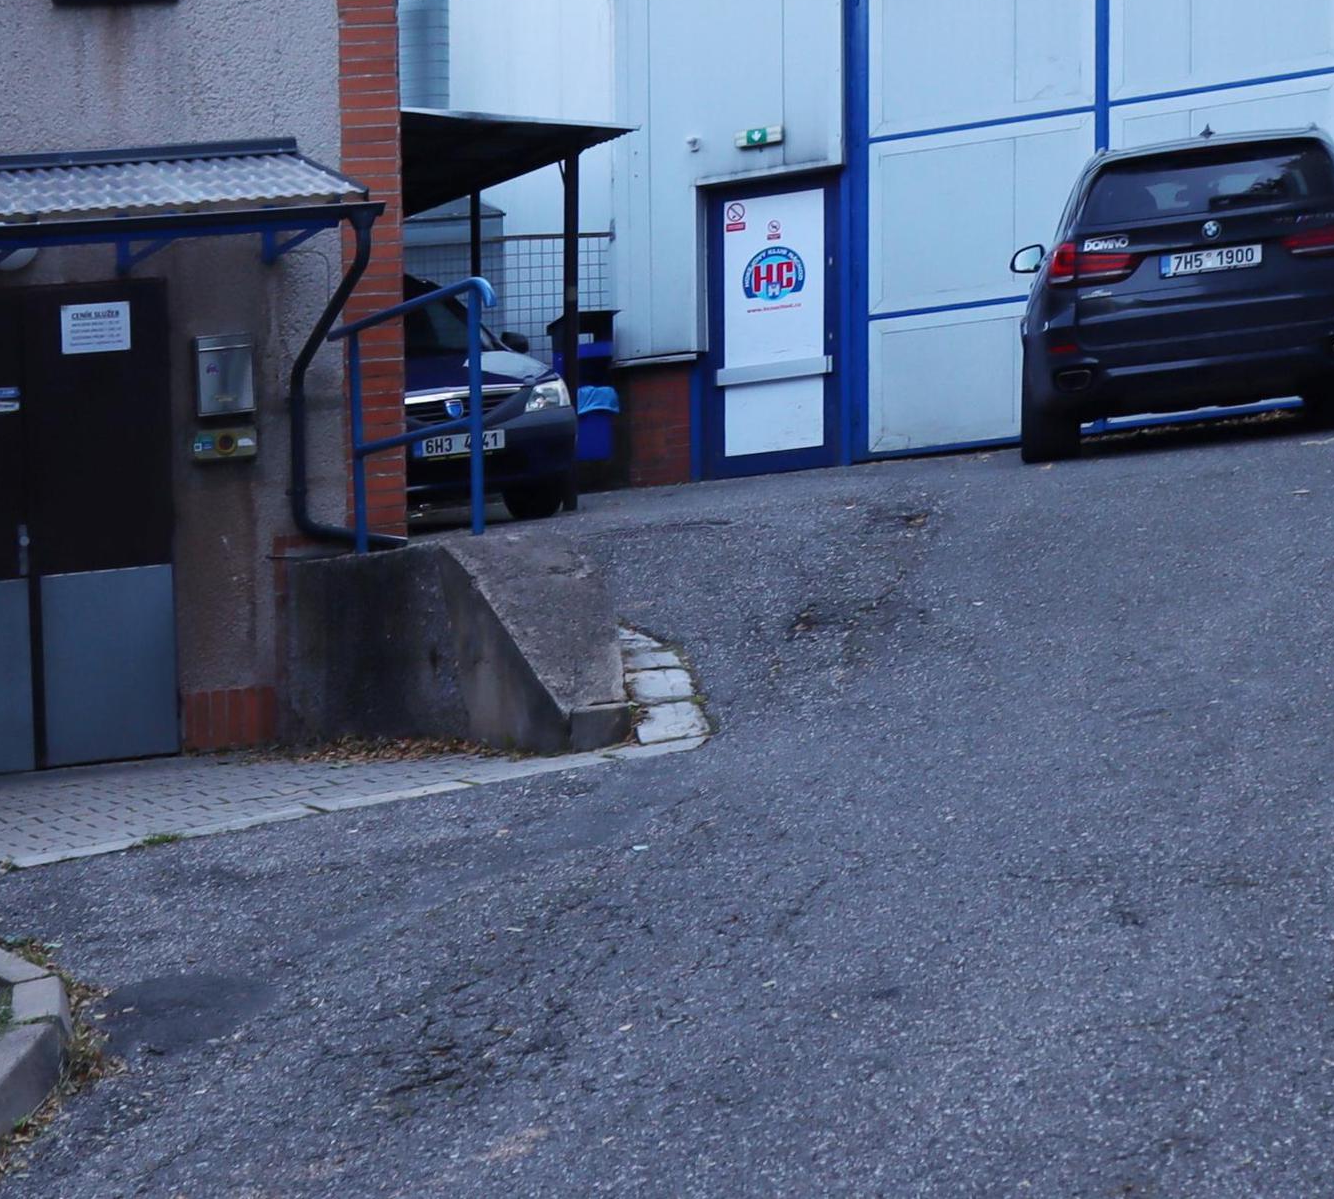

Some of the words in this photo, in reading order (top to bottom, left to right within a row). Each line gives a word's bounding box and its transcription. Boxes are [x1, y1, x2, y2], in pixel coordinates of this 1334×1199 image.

[1174, 253, 1203, 272] 7H5
[1217, 247, 1255, 266] 1900
[753, 261, 794, 293] HC
[425, 437, 453, 454] 6H3
[464, 432, 498, 449] 441
